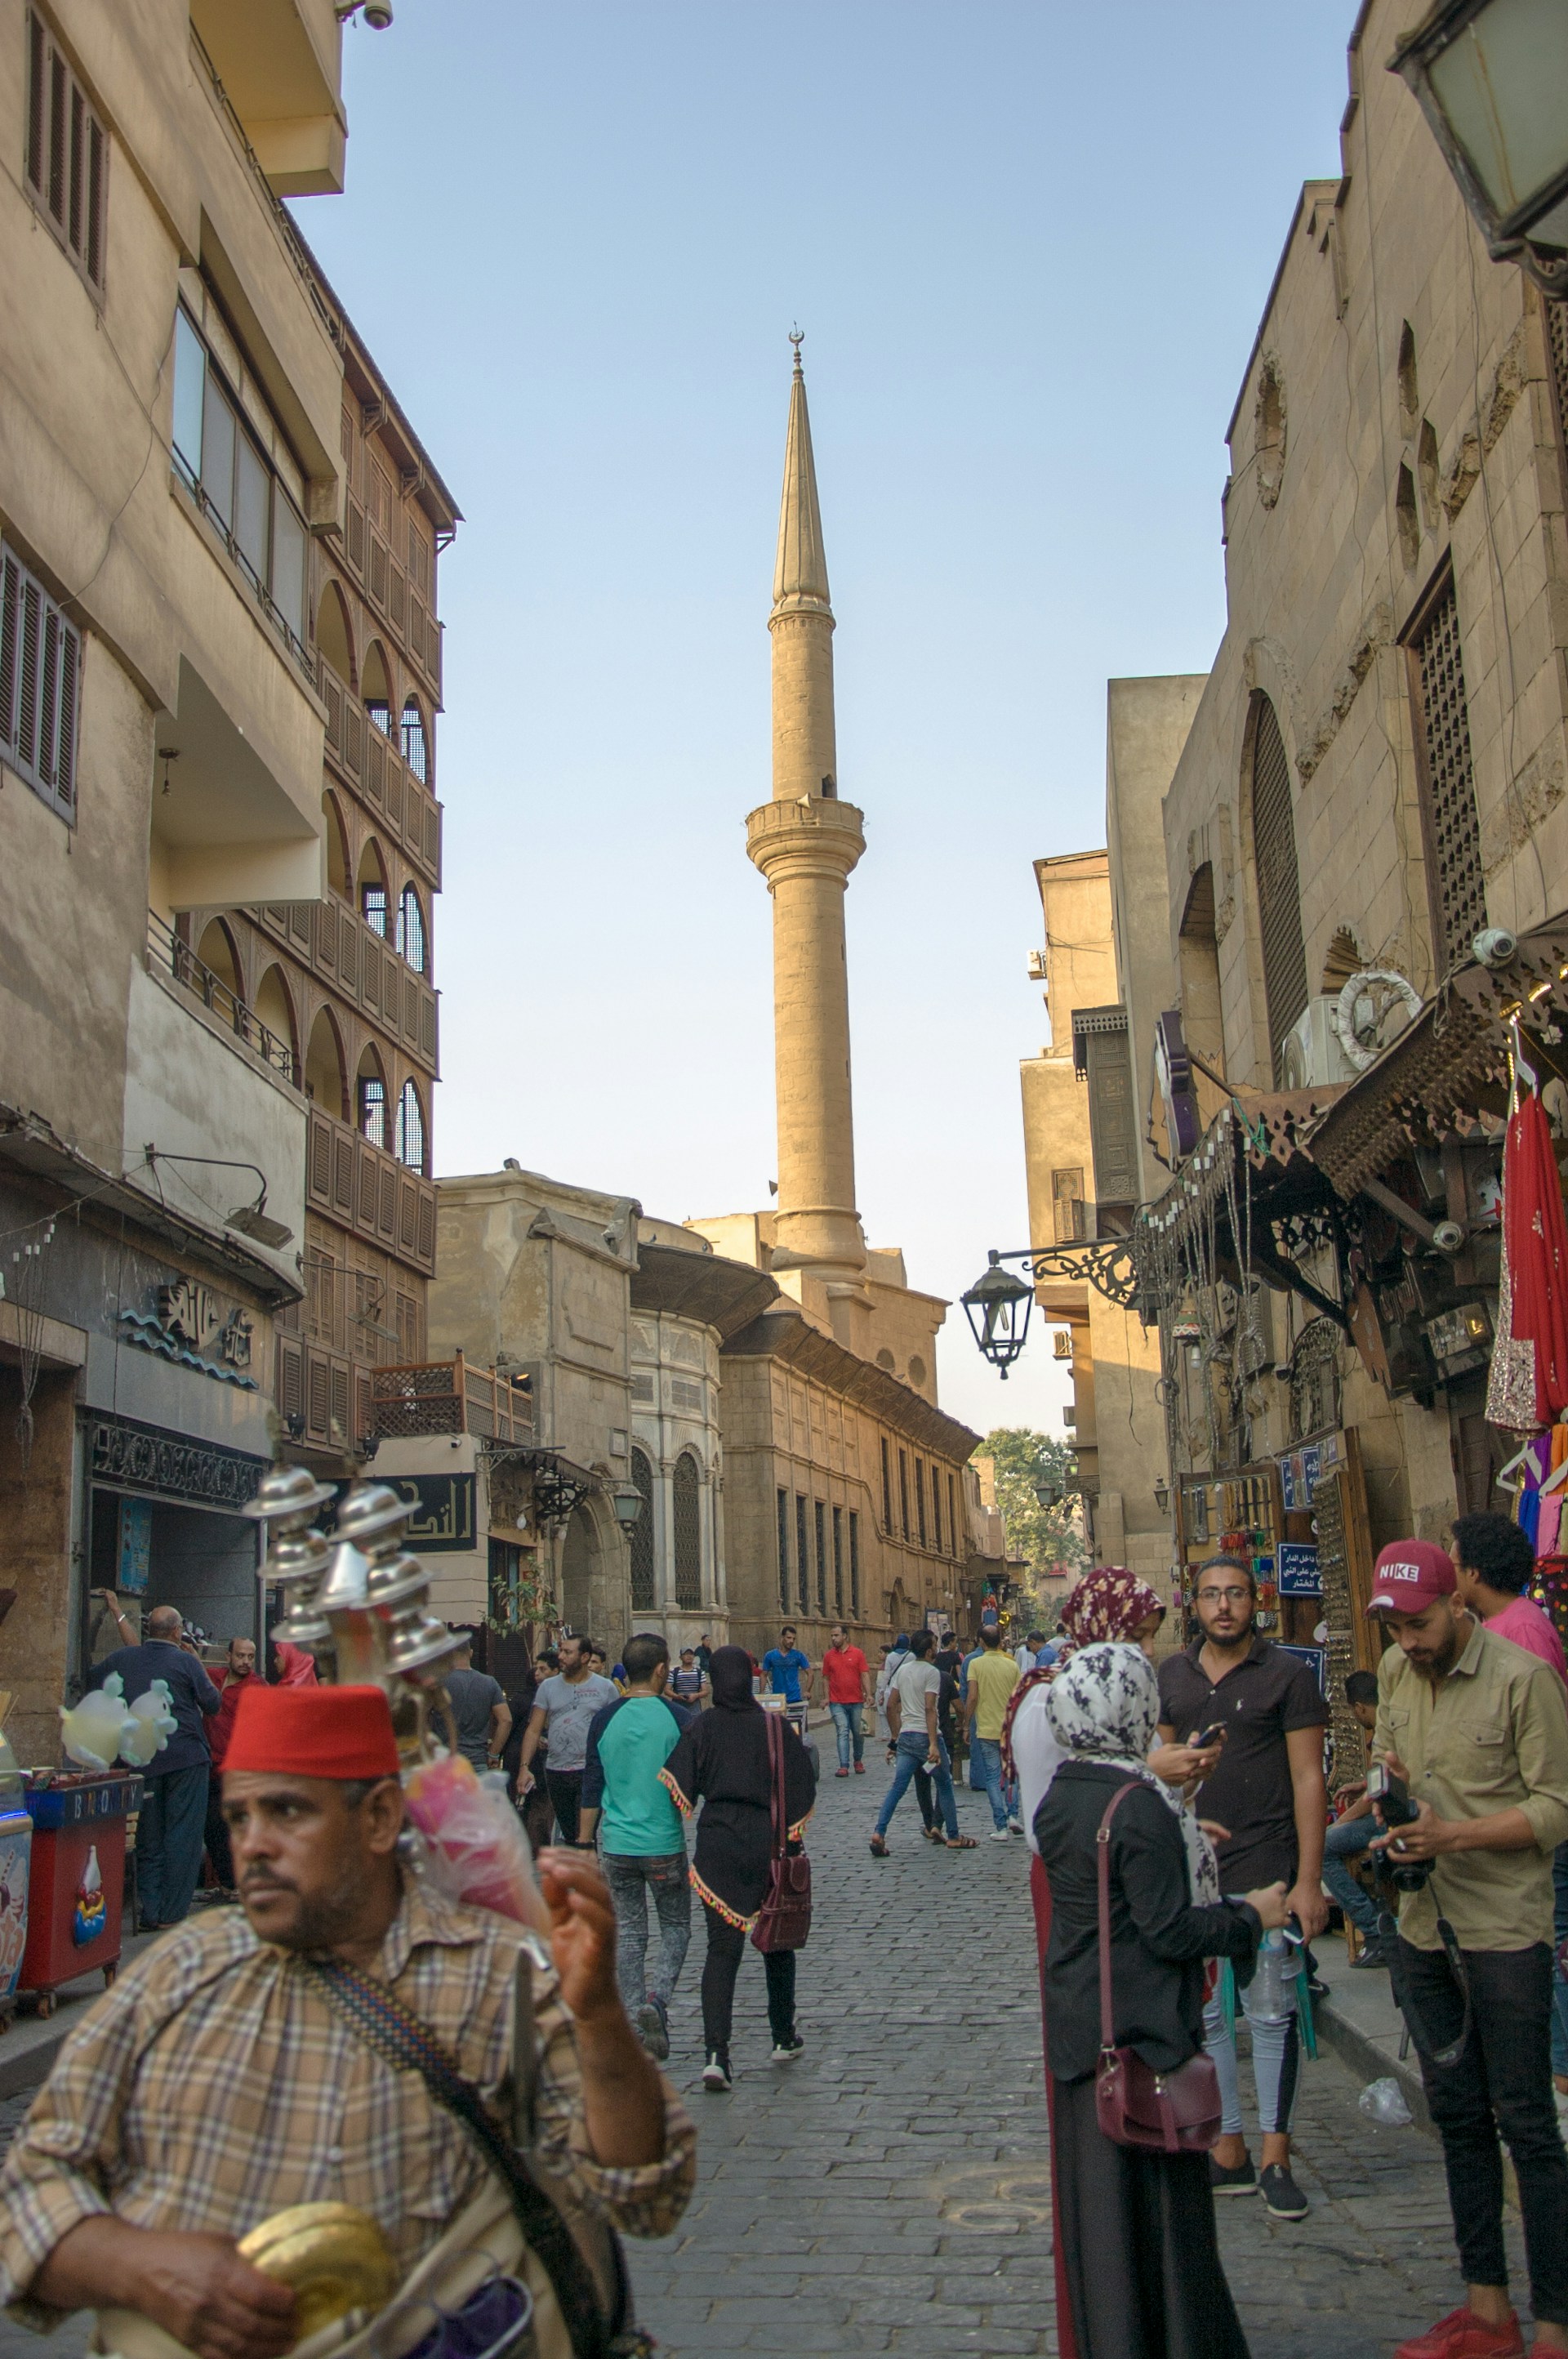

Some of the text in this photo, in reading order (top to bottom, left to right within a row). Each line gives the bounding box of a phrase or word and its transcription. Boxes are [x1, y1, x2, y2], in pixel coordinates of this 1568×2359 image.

[1285, 1554, 1299, 1563] الدار
[1379, 1563, 1418, 1581] NIKE
[1293, 1579, 1315, 1588] المختار
